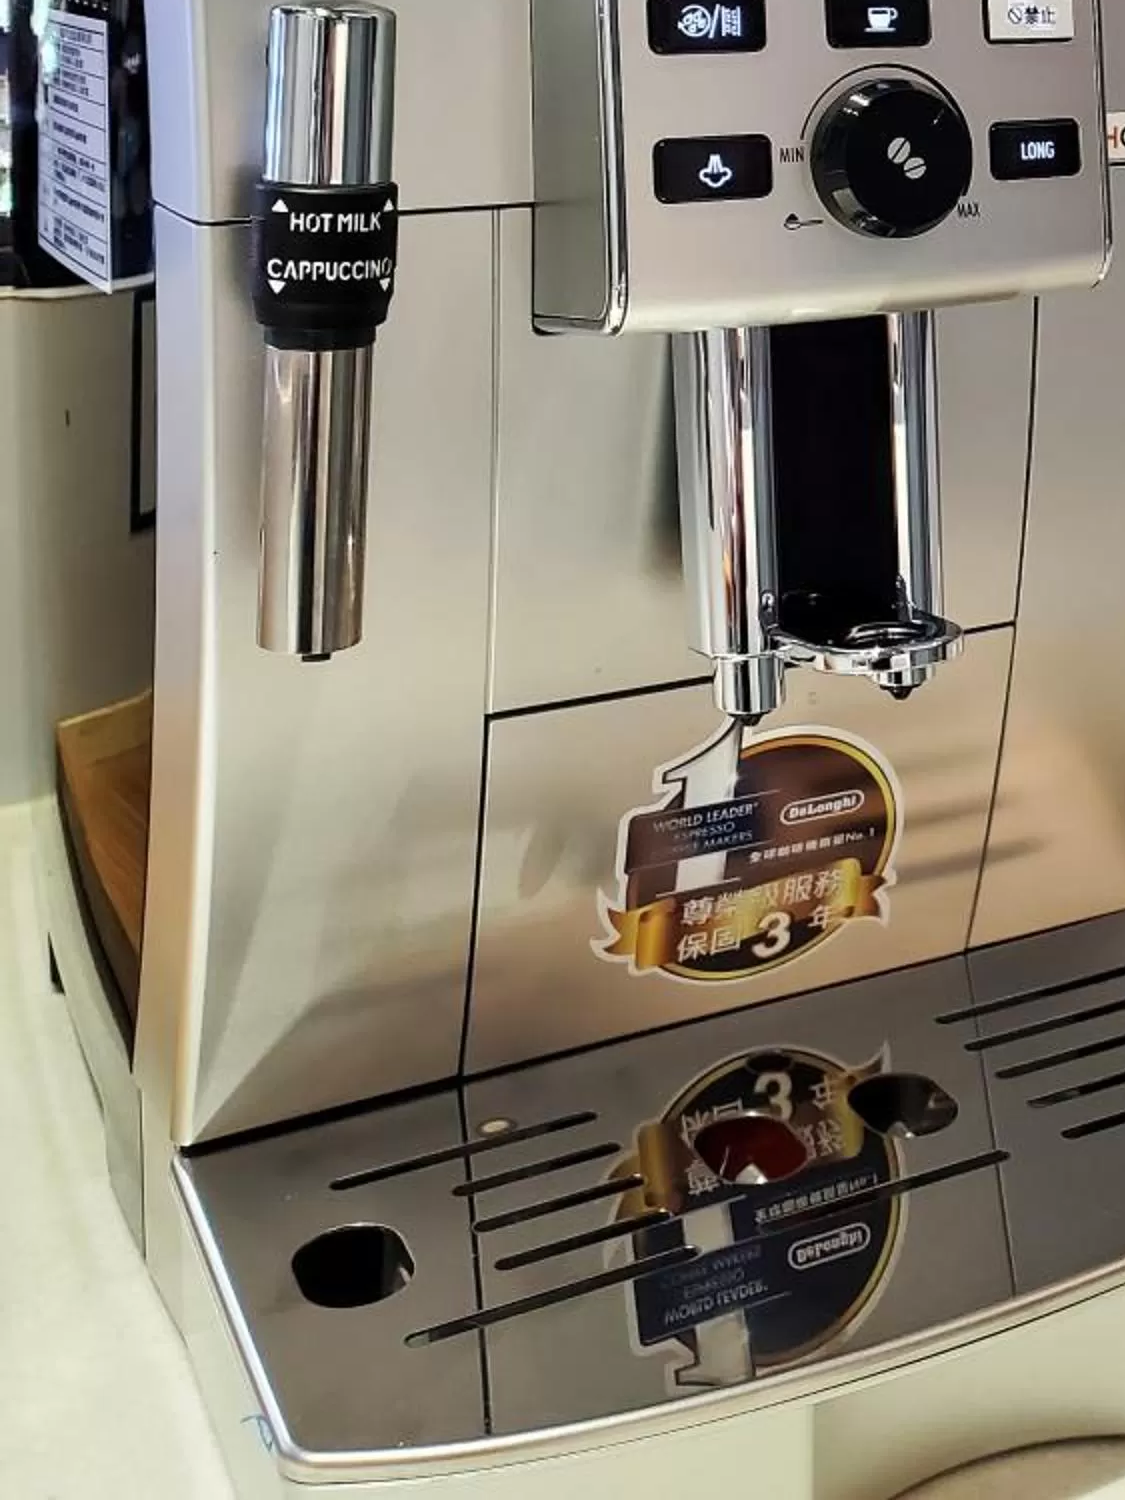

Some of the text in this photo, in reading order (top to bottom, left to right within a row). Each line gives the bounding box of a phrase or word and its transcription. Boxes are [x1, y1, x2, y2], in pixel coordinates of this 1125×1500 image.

[1024, 5, 1056, 25] 禁止
[779, 147, 805, 163] MIN
[1020, 141, 1055, 161] LONG
[956, 203, 980, 218] MAX
[289, 211, 381, 233] HOT MILK
[266, 257, 393, 281] CAPPUCCINO
[653, 812, 704, 833] WORLD
[703, 829, 753, 848] MAKERS
